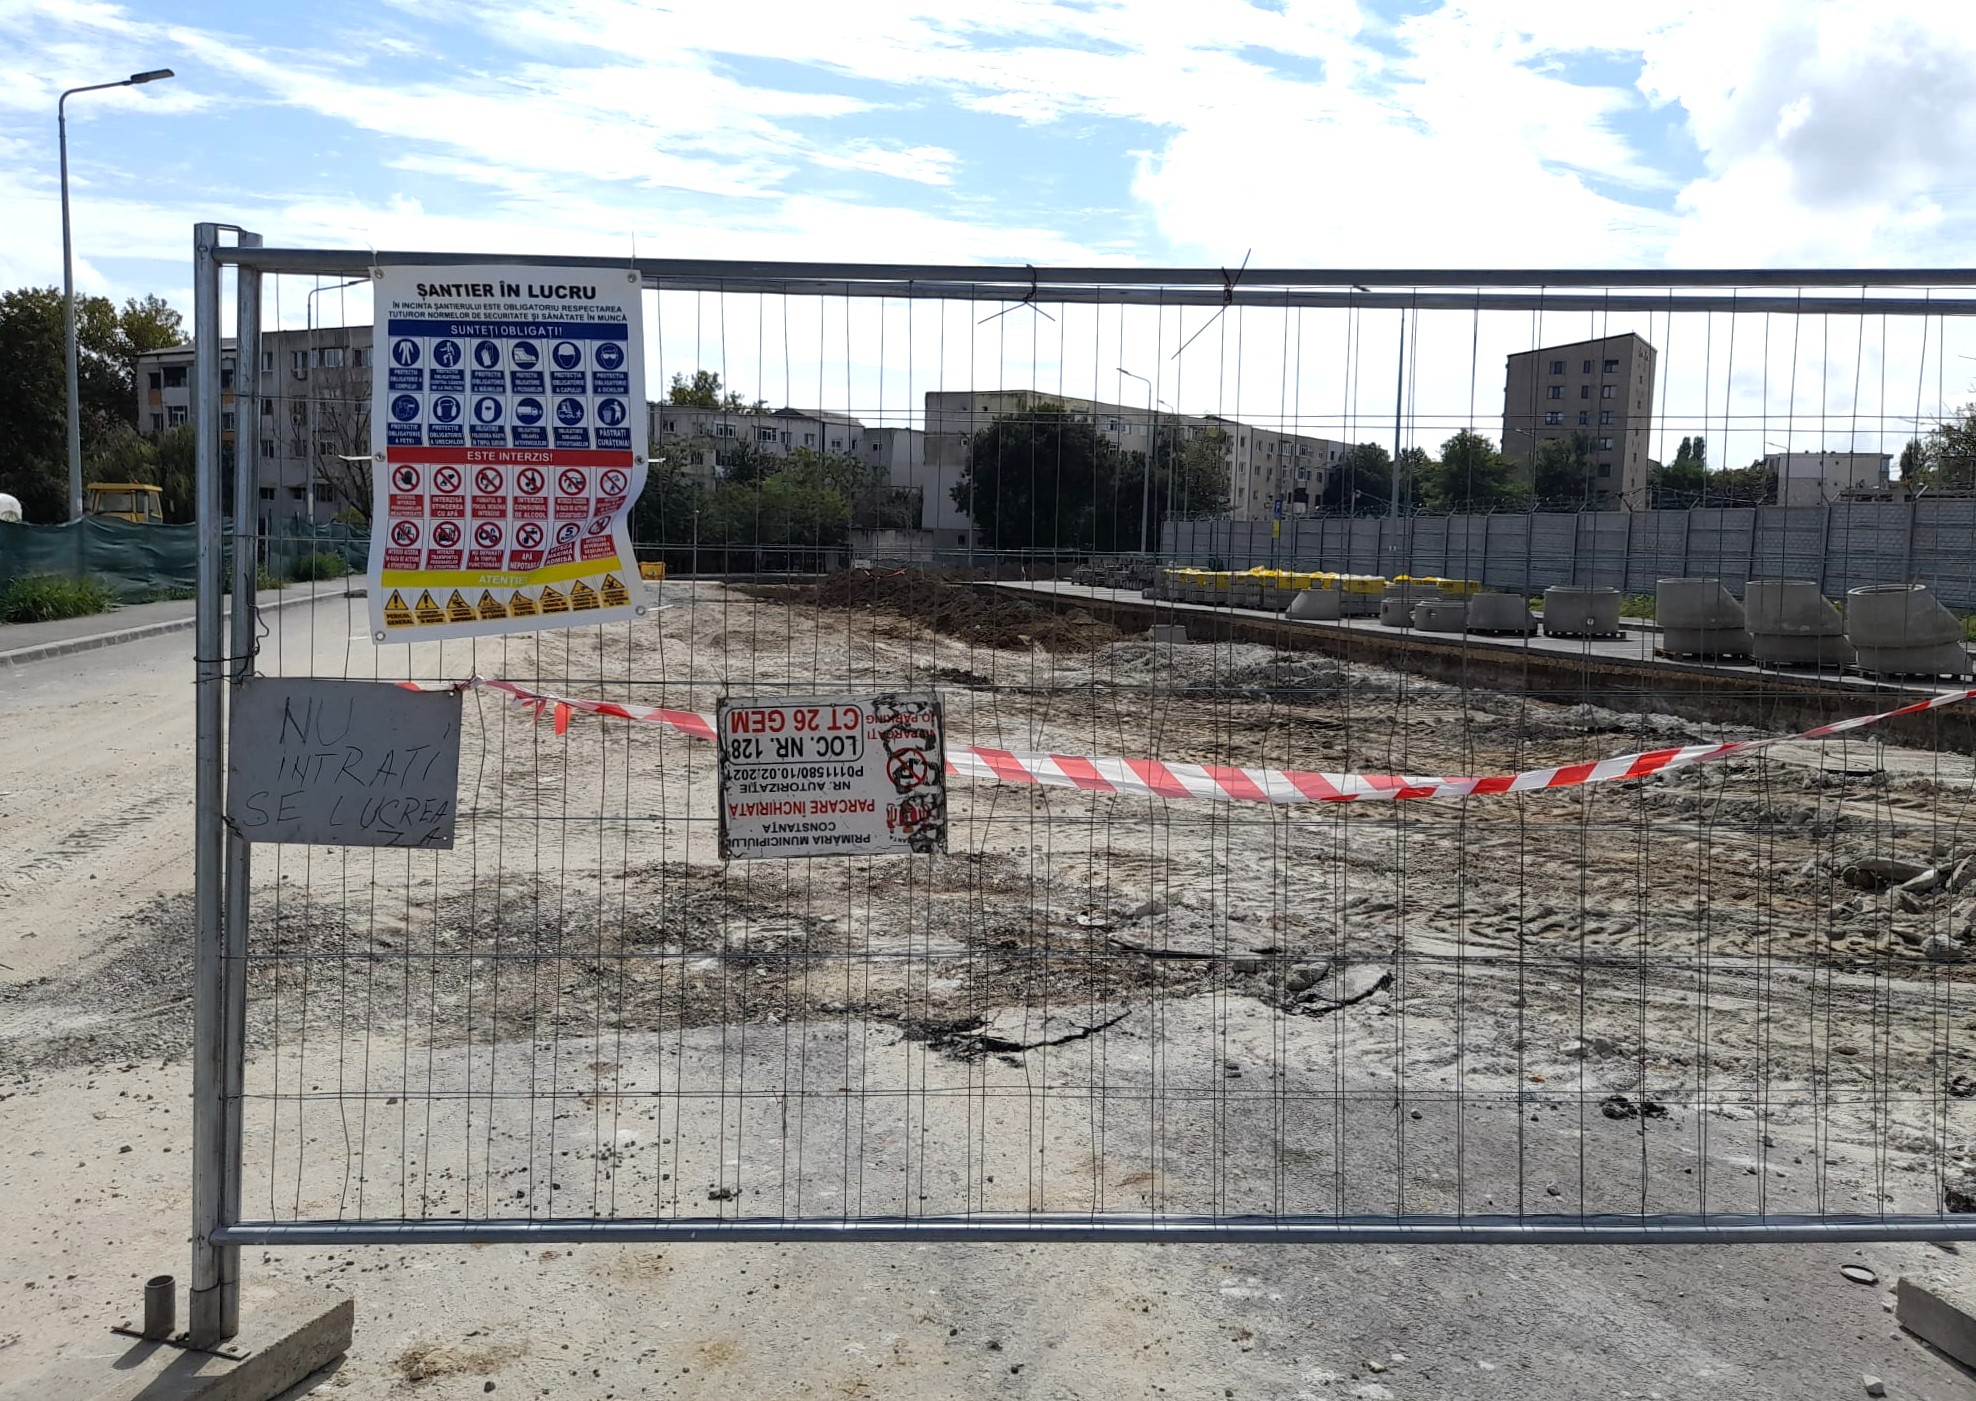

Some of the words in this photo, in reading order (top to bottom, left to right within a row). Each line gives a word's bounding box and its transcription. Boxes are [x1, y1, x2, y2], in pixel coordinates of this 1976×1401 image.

[416, 283, 495, 301] ȘANTIER
[499, 280, 520, 298] ÎN
[528, 284, 596, 300] LUCRU
[392, 300, 400, 309] ÎN
[401, 302, 433, 310] INCINTA
[483, 303, 501, 311] ESTE
[503, 303, 560, 312] OBLIGATORIU
[561, 304, 623, 313] RESPECTAREA
[388, 311, 426, 319] TUTUROR
[427, 312, 472, 320] NORMELOR
[472, 312, 481, 320] DE
[483, 312, 530, 321] SECURITATE
[587, 313, 596, 322] ÎN
[450, 325, 498, 338] SUNTEȚI
[500, 325, 563, 339] OBLIGAȚI!
[467, 451, 496, 461] ESTE
[499, 451, 553, 463] INTERZIS!
[279, 696, 353, 746] NU
[731, 709, 786, 734] GEM
[793, 708, 820, 732] 26
[827, 707, 860, 731] CT
[866, 714, 918, 725] PARKING
[731, 737, 763, 760] 128
[770, 736, 804, 758] NR.
[811, 735, 857, 757] LOC.
[739, 781, 826, 794] AUTORIZAȚIE
[828, 781, 851, 792] NR.
[243, 790, 304, 827] SE
[329, 795, 449, 829] LUCREA
[728, 801, 806, 819] ÎNCHIRIATĂ
[810, 799, 875, 815] PARCARE
[762, 821, 836, 834] CONSTANȚA
[812, 834, 871, 847] PRIMĂRIA
